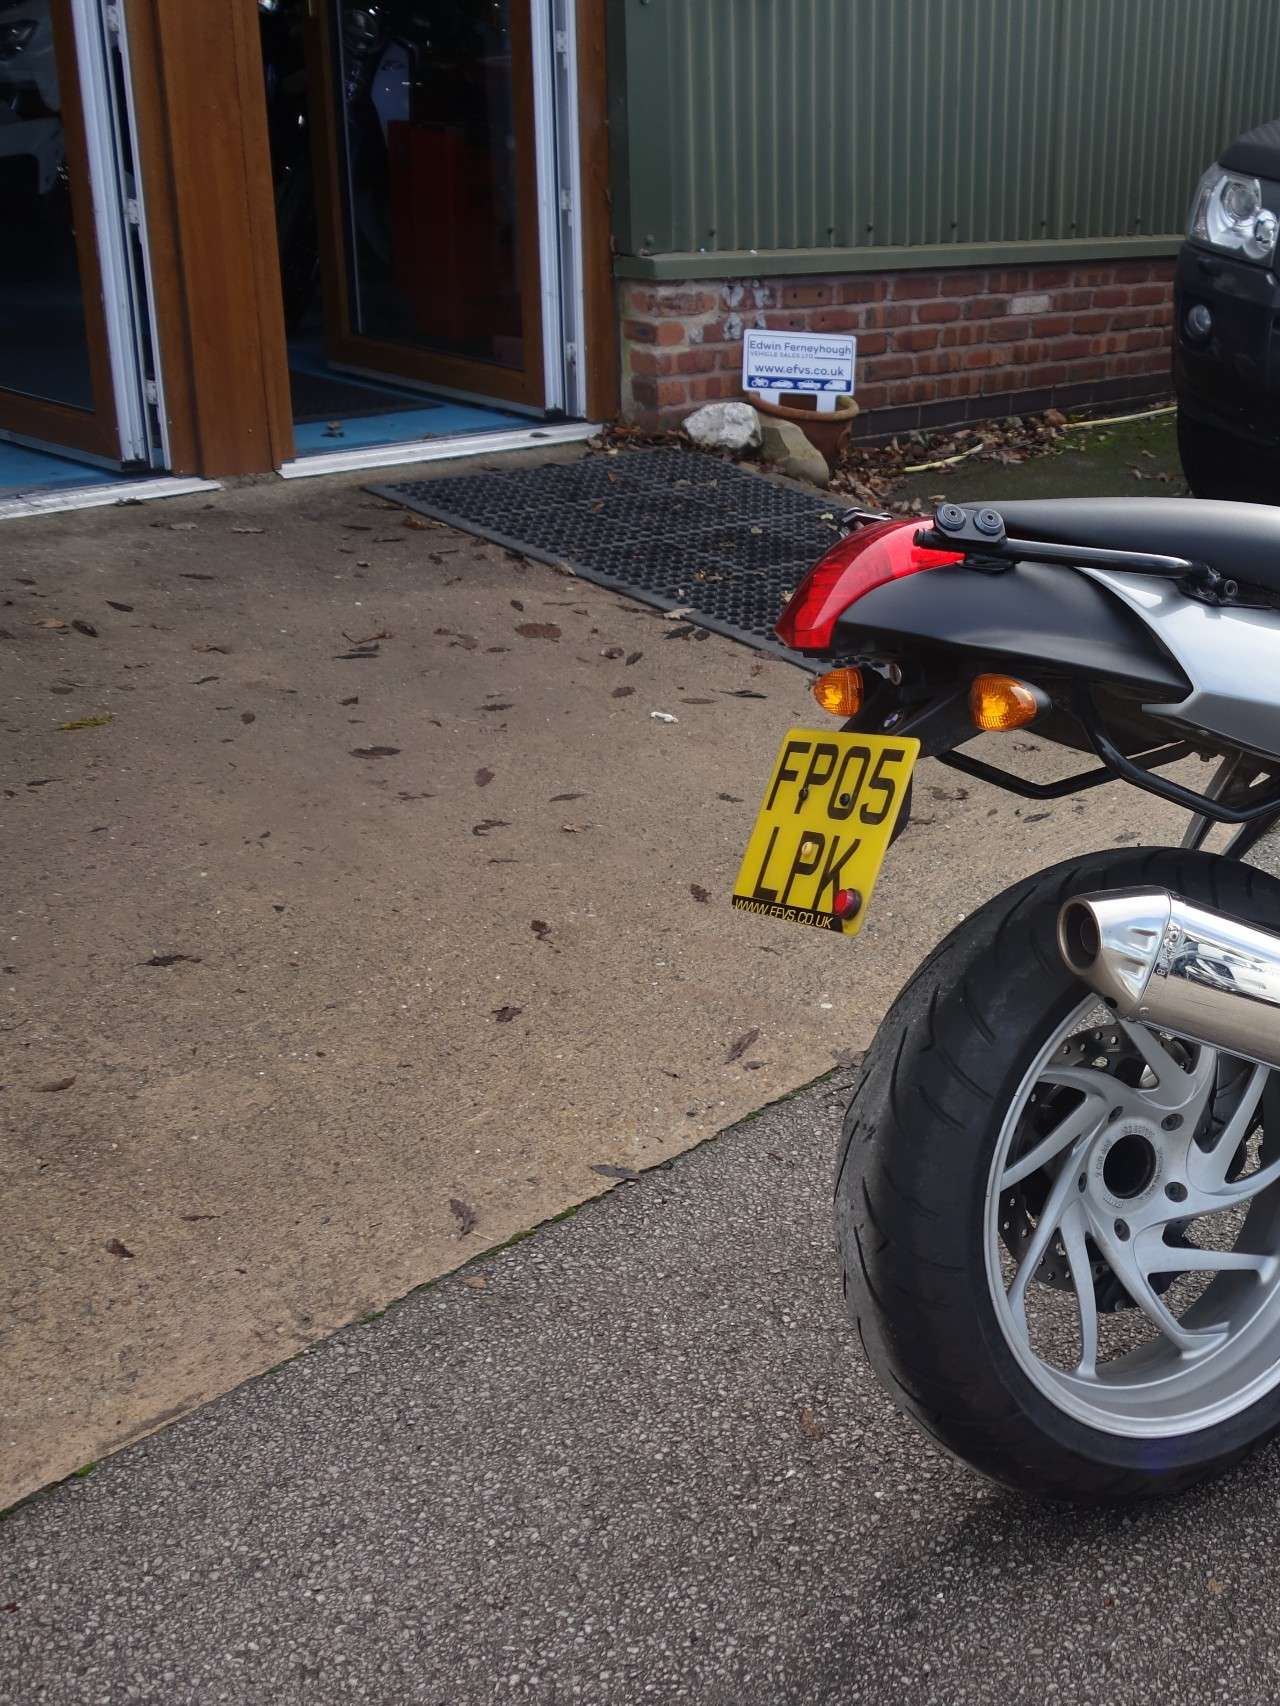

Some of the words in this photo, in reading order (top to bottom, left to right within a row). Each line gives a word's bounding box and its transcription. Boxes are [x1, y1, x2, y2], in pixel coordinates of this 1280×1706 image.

[749, 340, 782, 350] Edwin
[784, 342, 851, 357] Ferneyhough
[754, 364, 844, 376] www.efvs.co.uk
[766, 740, 906, 825] FP05
[753, 826, 861, 914] LPK
[735, 898, 833, 930] WWW.EFVS.CO.UK
